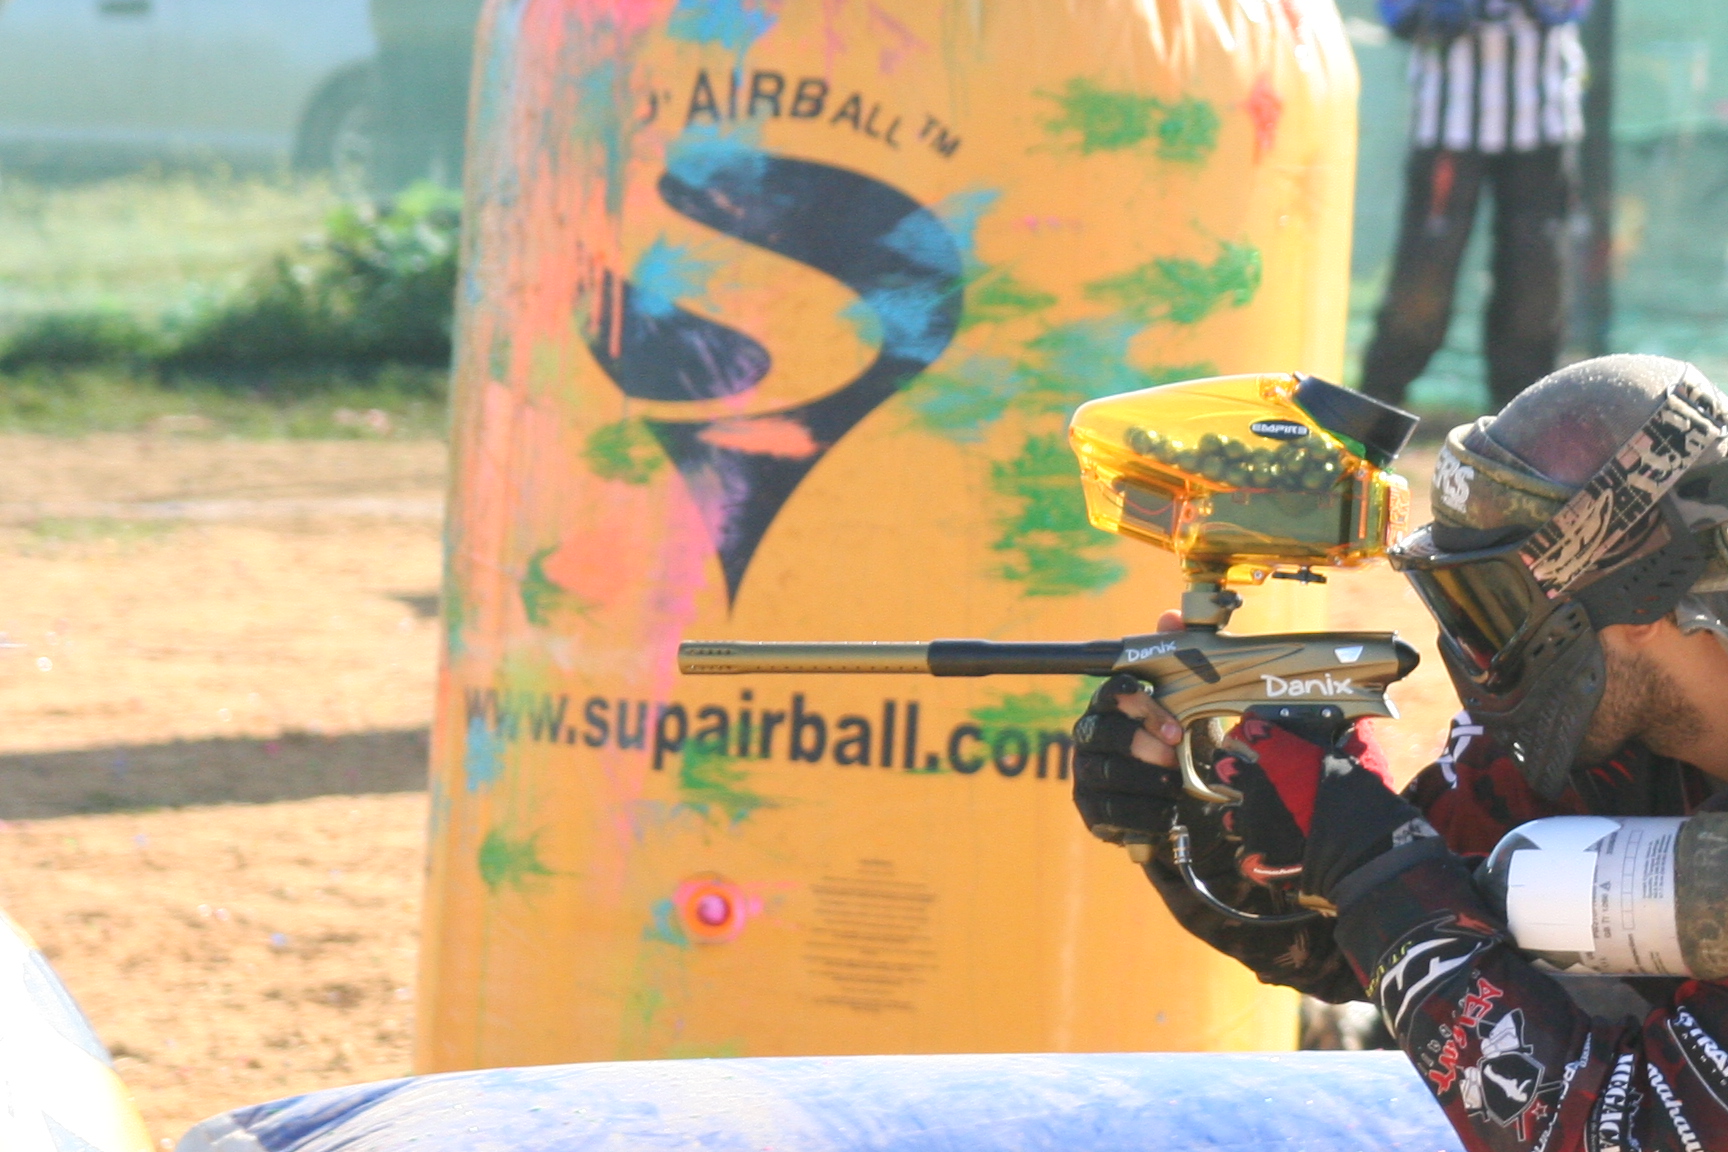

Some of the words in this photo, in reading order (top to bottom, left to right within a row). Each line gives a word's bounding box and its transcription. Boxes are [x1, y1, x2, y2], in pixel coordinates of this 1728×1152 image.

[684, 67, 902, 149] AIRBALL
[1126, 640, 1177, 662] Danix
[1260, 673, 1354, 697] Danix
